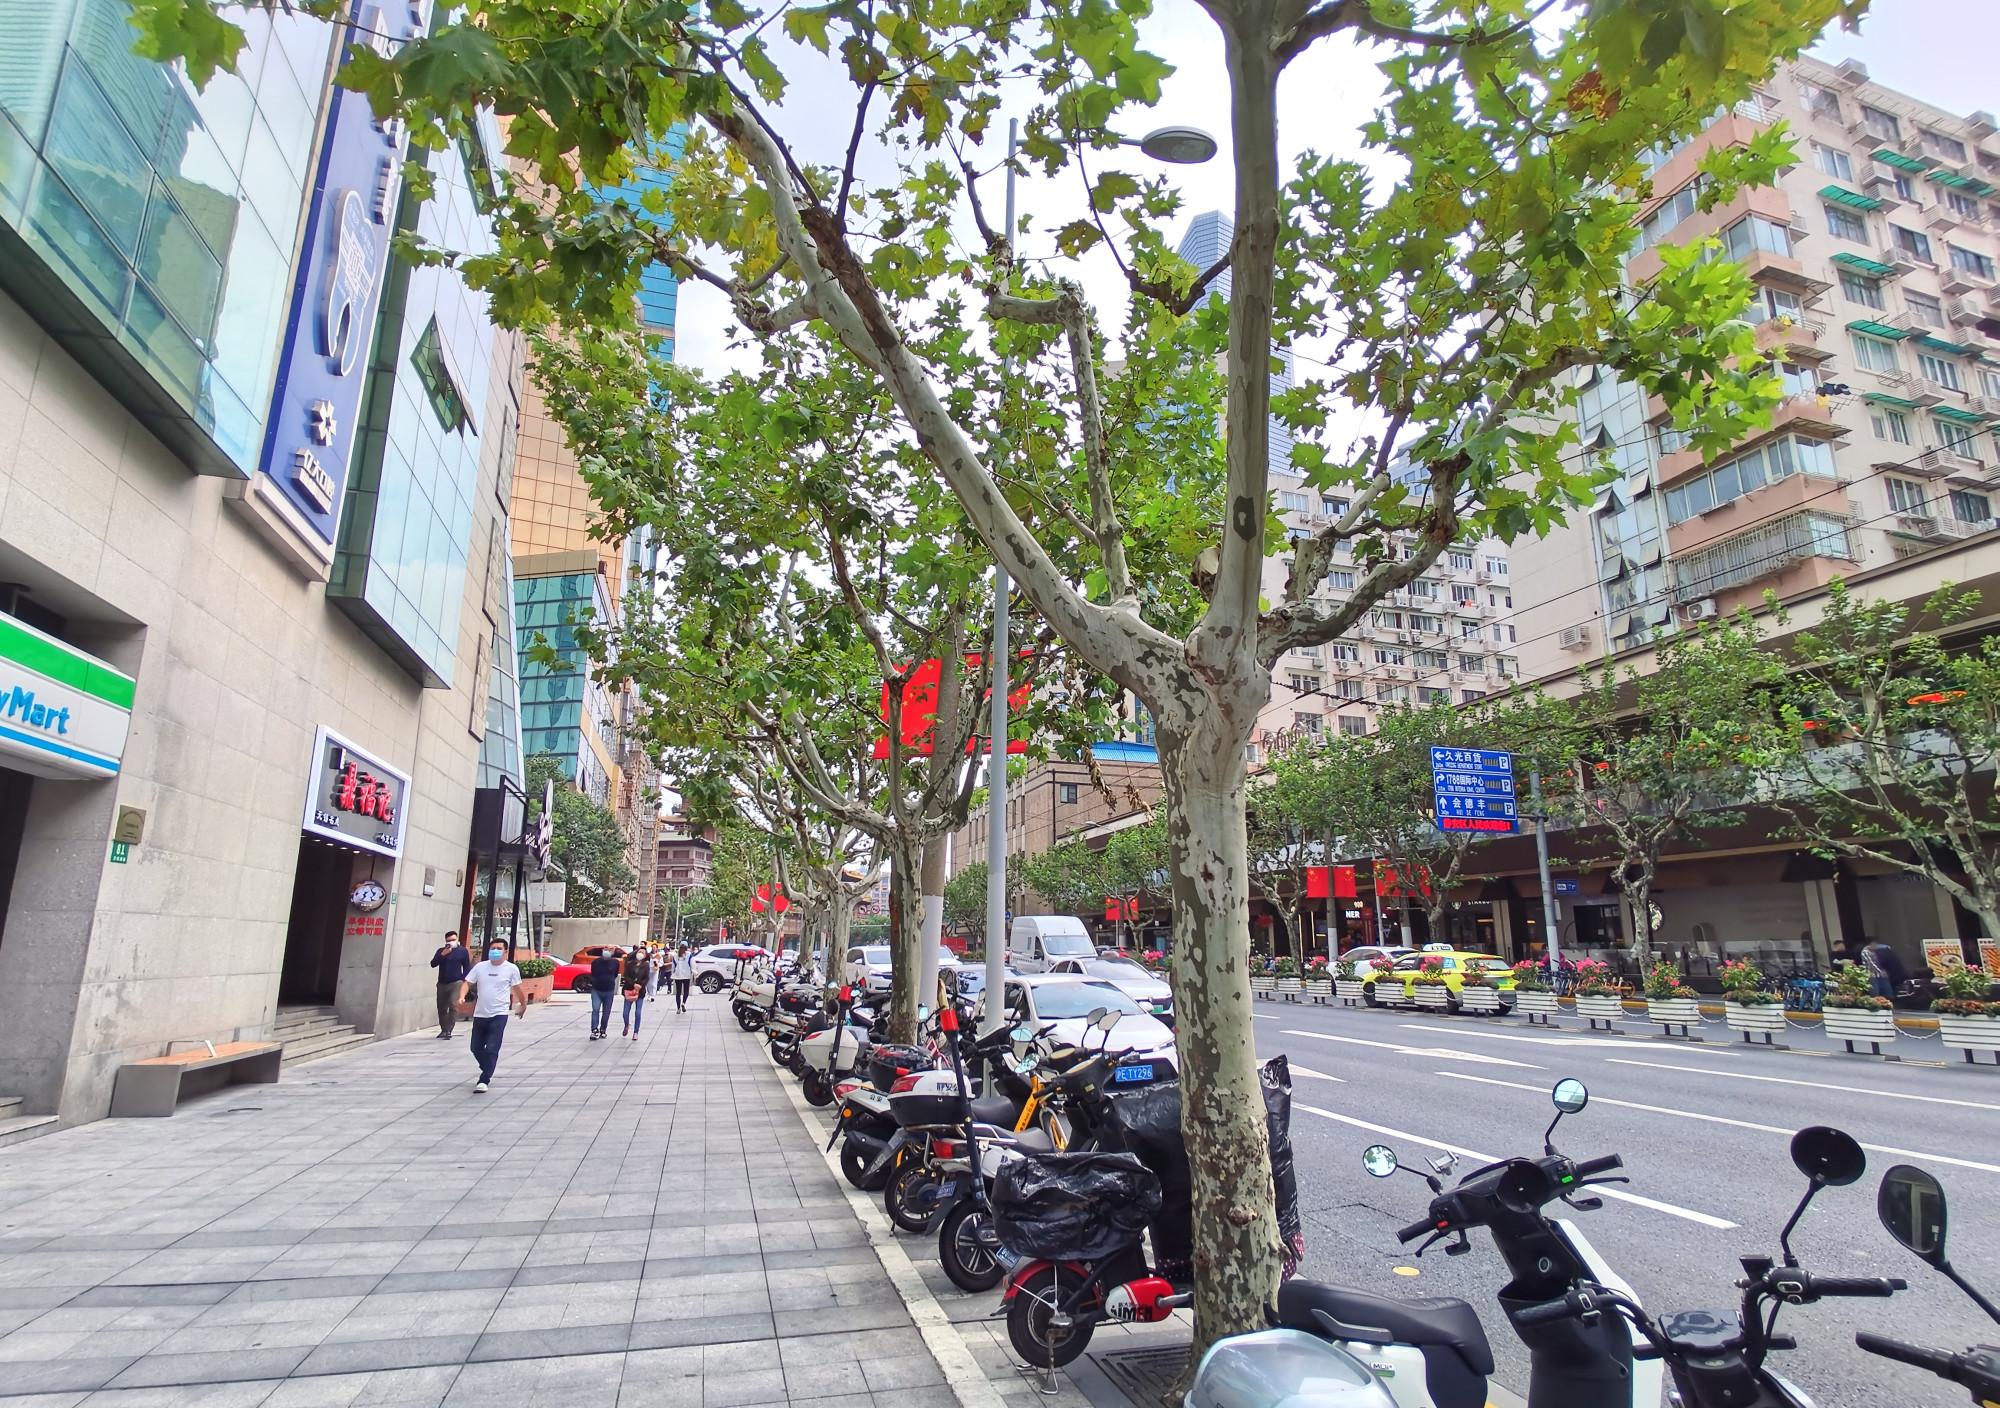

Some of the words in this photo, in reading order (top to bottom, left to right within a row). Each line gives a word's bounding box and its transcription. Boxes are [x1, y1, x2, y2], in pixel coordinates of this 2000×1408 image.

[1445, 750, 1482, 763] 久光百货
[1452, 797, 1486, 810] 会德丰
